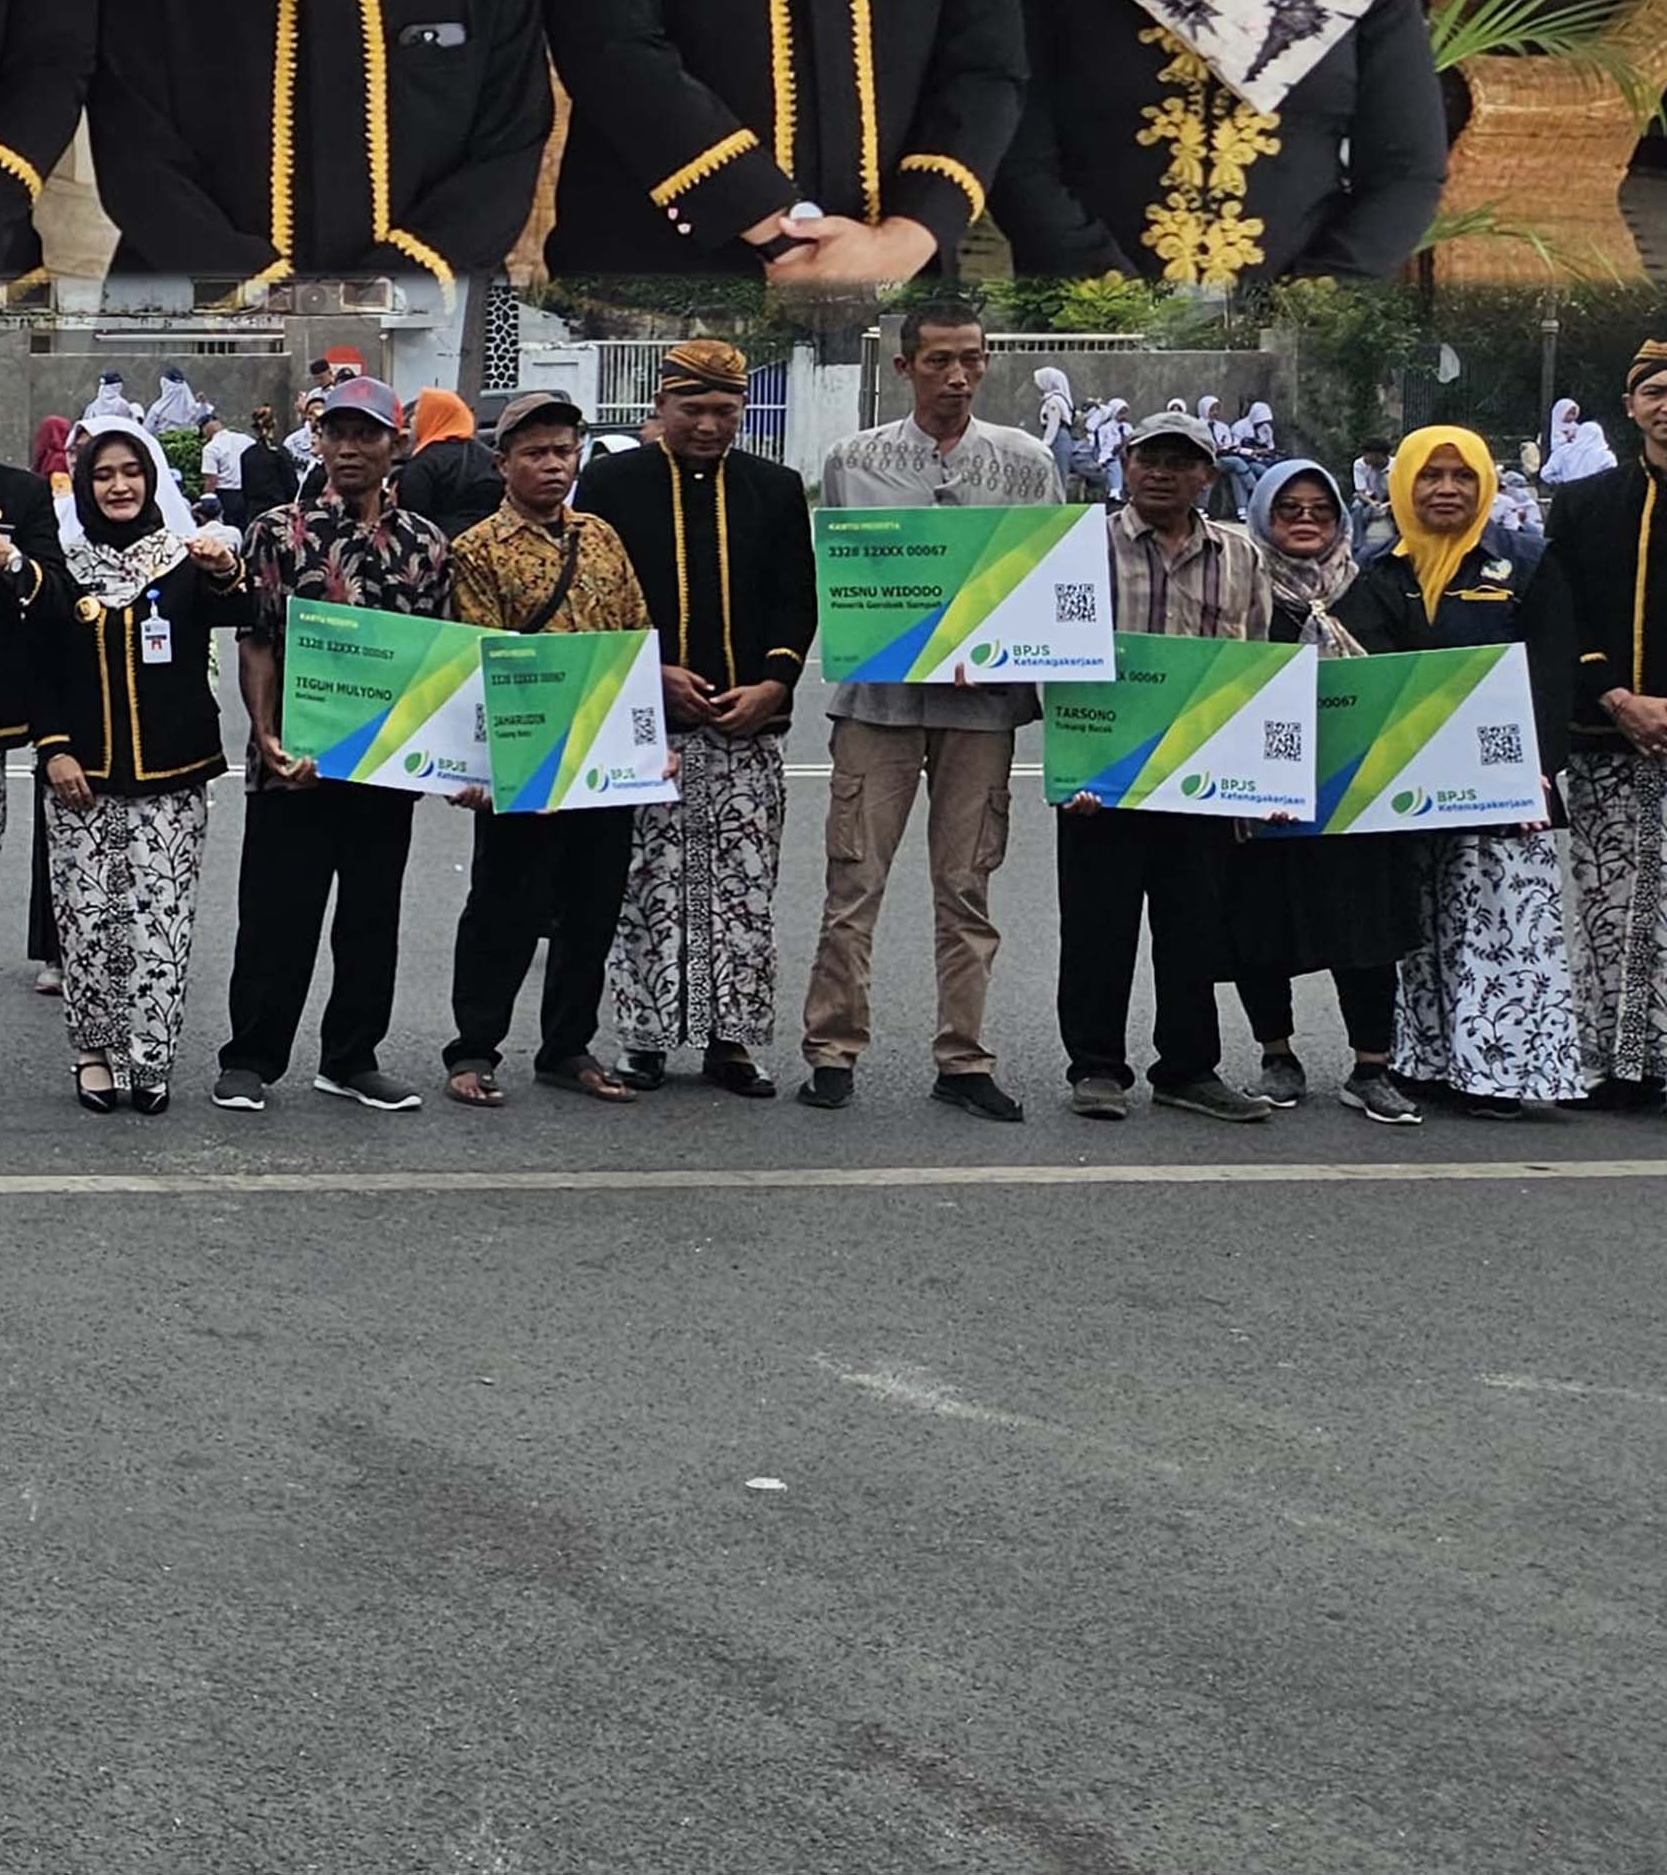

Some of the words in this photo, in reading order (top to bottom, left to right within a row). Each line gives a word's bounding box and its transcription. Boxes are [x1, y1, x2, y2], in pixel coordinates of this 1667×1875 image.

[829, 585, 878, 598] WISNU
[881, 585, 943, 598] WIDODO
[1013, 644, 1050, 657] BPJS
[1013, 657, 1105, 669] Ketenagakerjaan
[296, 676, 334, 693] TEGUH
[336, 681, 393, 701] MULYONO
[1055, 706, 1117, 722] TARSONO
[1220, 778, 1256, 792] BPJS
[1220, 791, 1306, 806] Ketenagakerjaan
[1437, 789, 1477, 803] BPJS
[1438, 798, 1534, 815] Ketenagakerjaan
